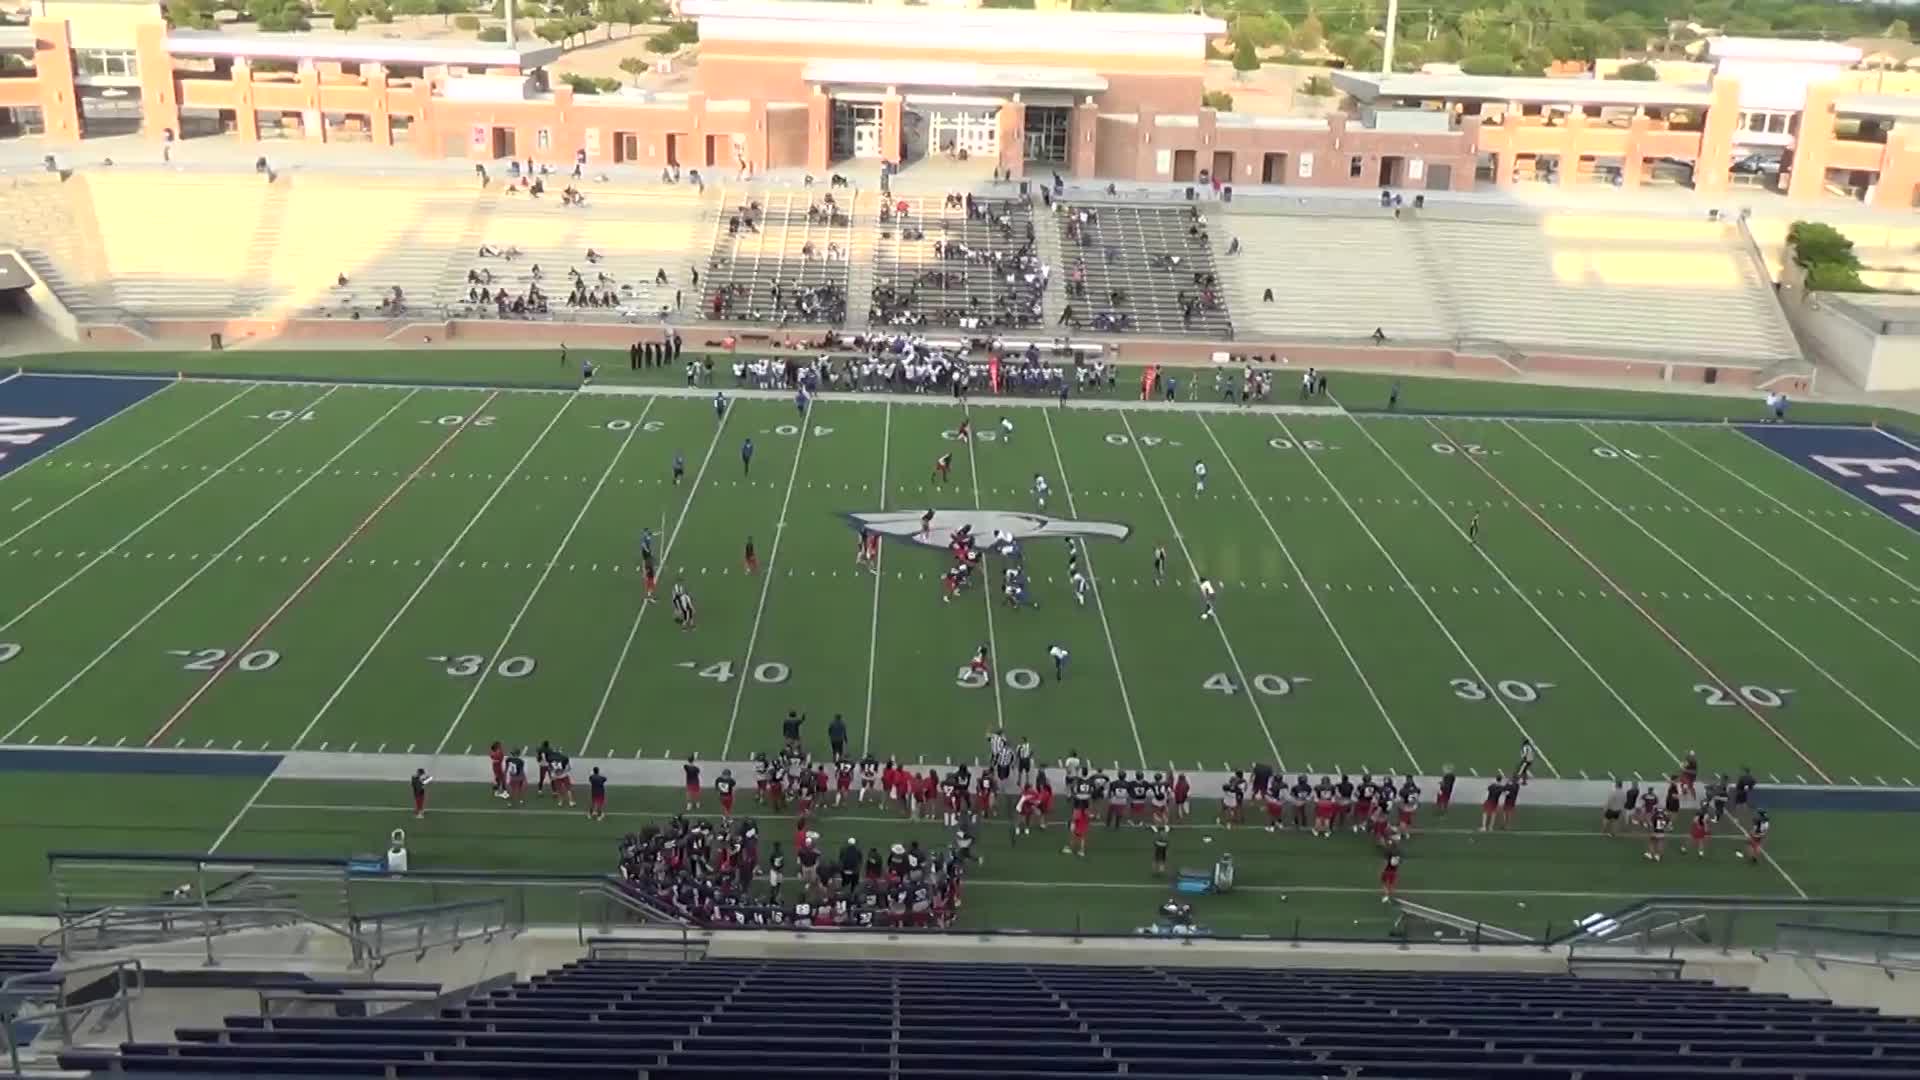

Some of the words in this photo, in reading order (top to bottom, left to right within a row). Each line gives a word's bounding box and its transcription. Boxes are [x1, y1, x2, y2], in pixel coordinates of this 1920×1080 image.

[183, 648, 280, 670] 20
[447, 655, 536, 677] 30
[698, 660, 789, 682] 40
[1203, 672, 1290, 696] 40
[1450, 678, 1537, 701] 30
[1693, 684, 1782, 707] 20
